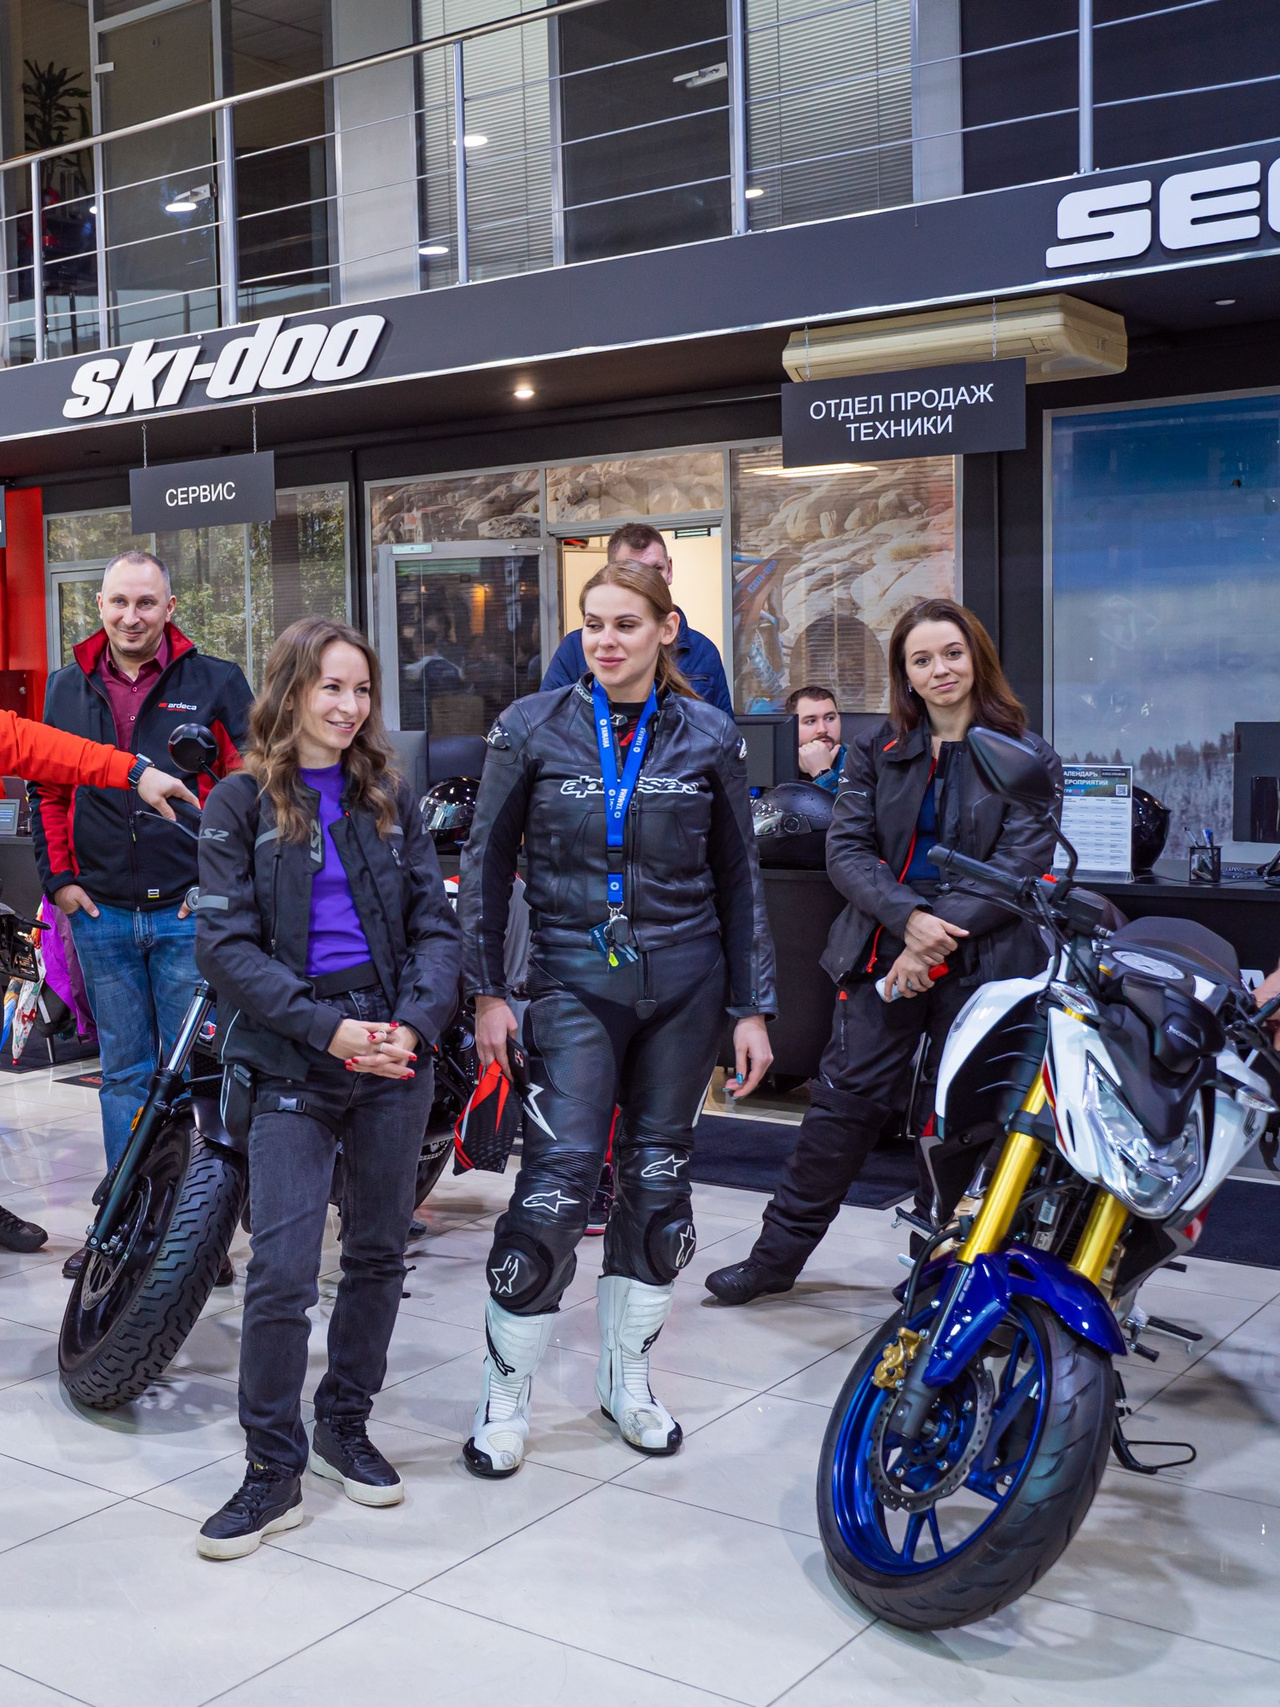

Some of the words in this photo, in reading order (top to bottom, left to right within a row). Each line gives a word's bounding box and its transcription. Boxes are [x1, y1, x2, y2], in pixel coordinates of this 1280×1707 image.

[1045, 157, 1280, 269] SE
[809, 394, 883, 421] ОТДЕЛ
[890, 383, 995, 412] ПРОДАЖ
[845, 414, 954, 442] ТЕХНИКИ
[165, 481, 237, 507] СЕРВИС
[167, 702, 197, 711] ardeca
[1064, 778, 1109, 786] ЕРОПРИЯТИЙ
